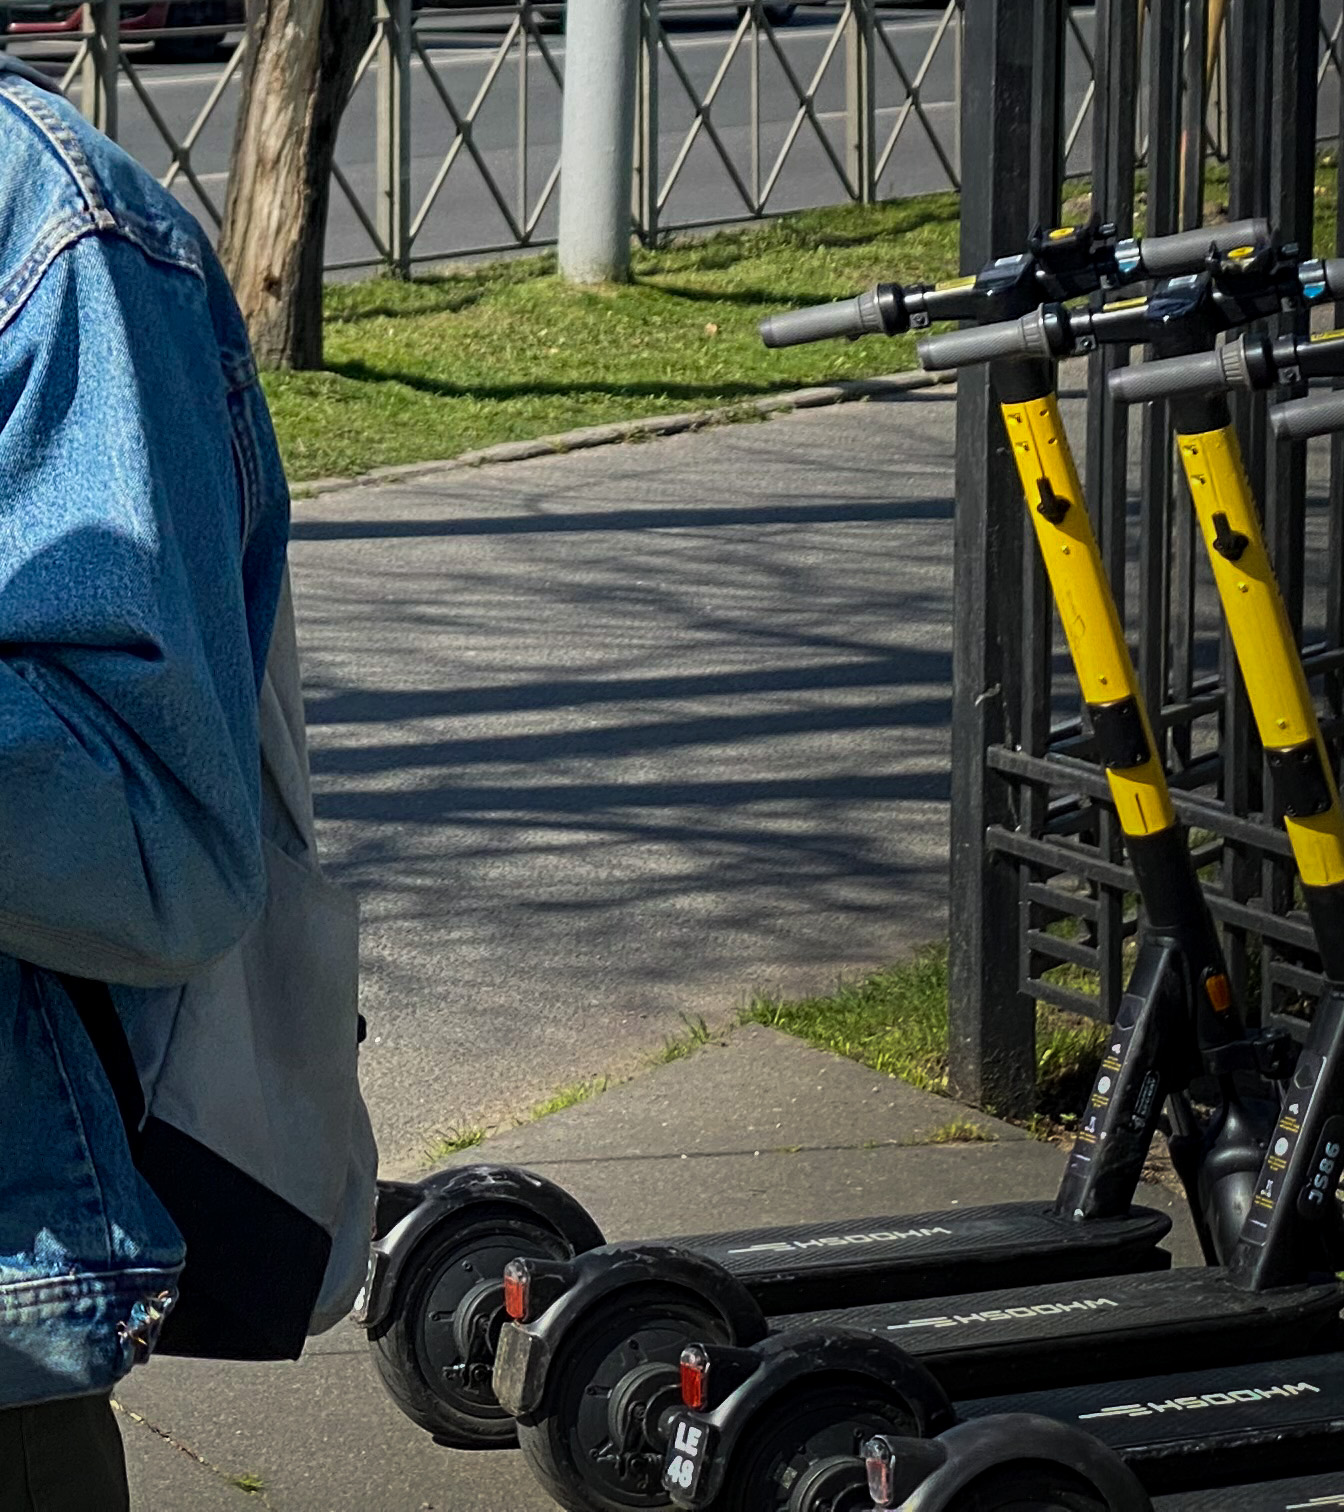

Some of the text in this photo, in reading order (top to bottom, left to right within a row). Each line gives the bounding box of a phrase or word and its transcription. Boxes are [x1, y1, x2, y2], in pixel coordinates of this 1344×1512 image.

[1308, 1141, 1340, 1205] JS86
[675, 1421, 703, 1457] LE
[667, 1455, 695, 1488] 48
